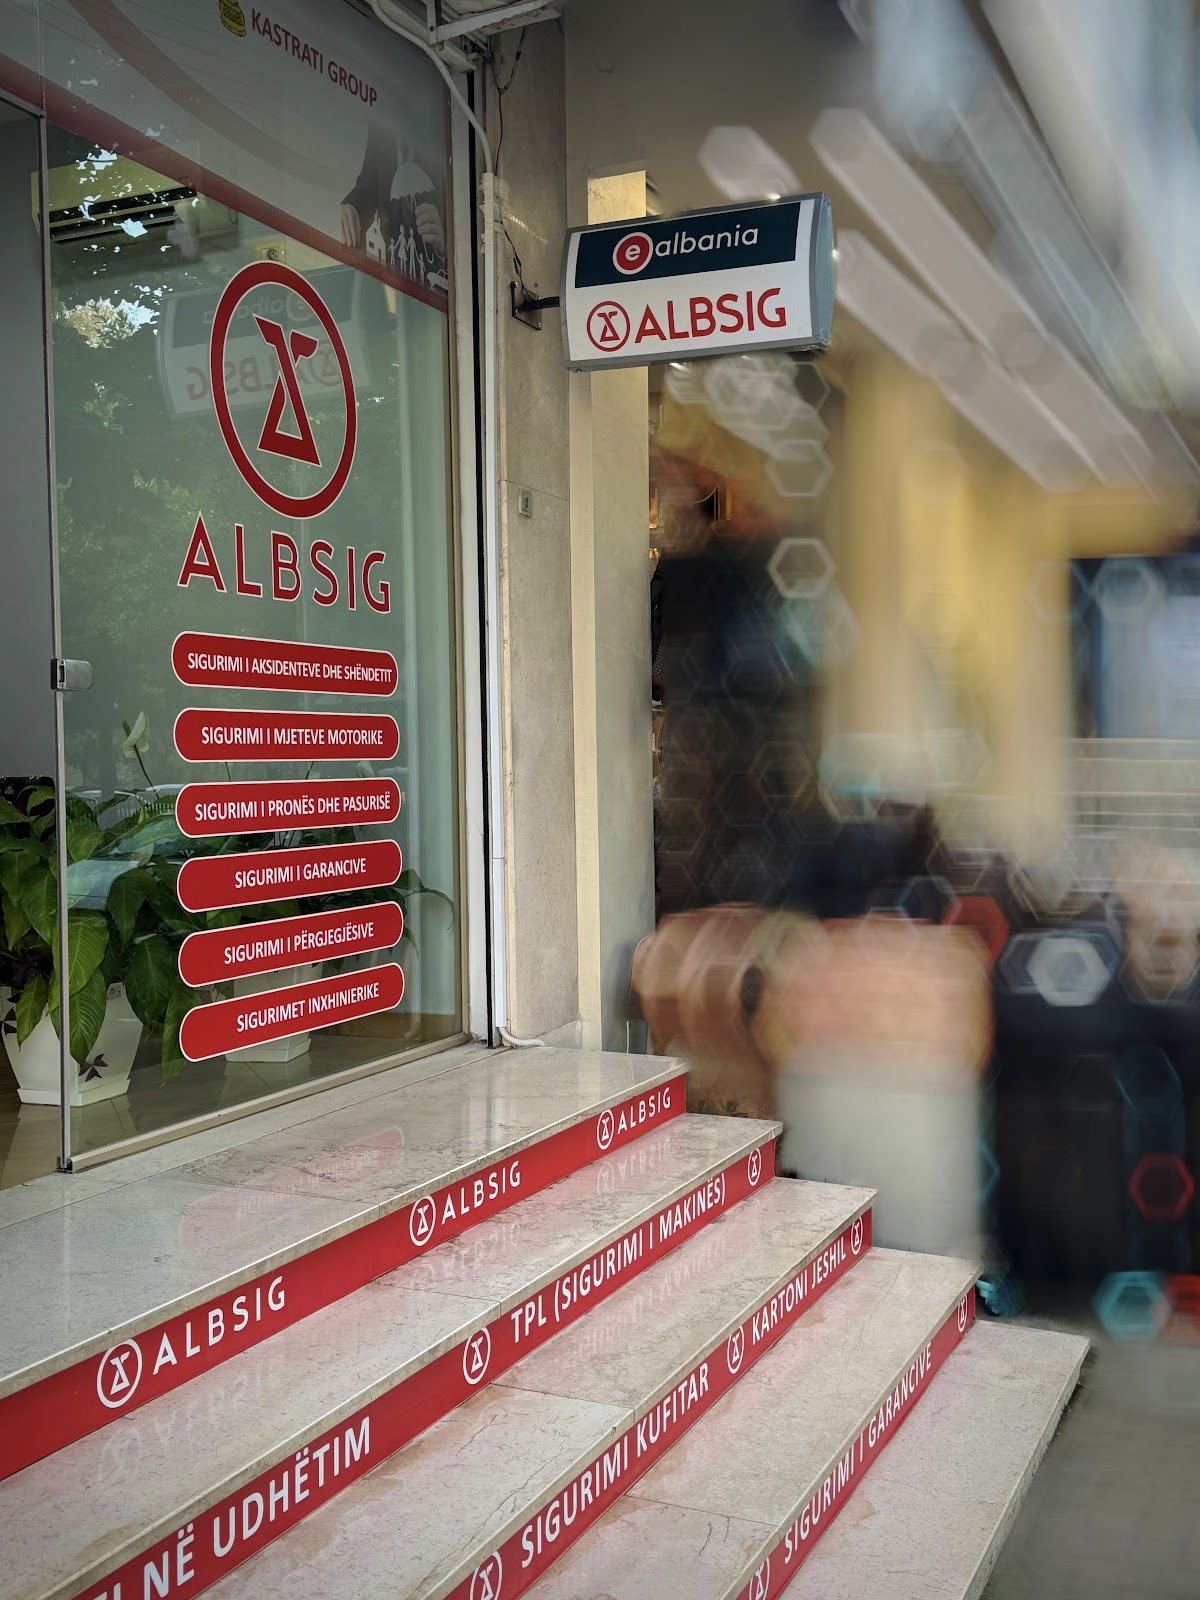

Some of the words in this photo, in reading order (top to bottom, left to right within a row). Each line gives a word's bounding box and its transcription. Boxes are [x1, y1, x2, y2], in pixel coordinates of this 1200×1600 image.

[251, 8, 323, 74] KASTRATI
[328, 60, 377, 107] GROUP
[624, 243, 641, 260] e
[655, 224, 759, 258] albania
[634, 287, 787, 344] ALBSIG
[177, 510, 391, 615] ALBSIG
[187, 653, 243, 673] SIGURIMI
[245, 657, 250, 673] I
[251, 658, 321, 678] AKSIDENTEVE
[323, 664, 342, 680] DHE
[344, 663, 392, 683] SHËNDETIT
[201, 726, 263, 745] SIGURIMI
[266, 728, 271, 745] I
[274, 728, 325, 745] MJETEVE
[327, 729, 383, 745] MOTORIKE
[195, 802, 258, 821] SIGURIMI
[261, 801, 265, 818] I
[268, 795, 315, 817] PRONËS
[317, 799, 340, 814] DHE
[343, 791, 391, 812] PASURISË
[235, 866, 294, 889] SIGURIMI
[296, 865, 301, 881] I
[303, 857, 366, 880] GARANCIVE
[224, 938, 284, 965] SIGURIMI
[287, 937, 291, 953] I
[294, 921, 374, 951] PËRGJEGJËSIVE
[236, 1000, 305, 1033] SIGURIMET
[308, 982, 380, 1014] INXHINIERIKE
[617, 1087, 671, 1135] ALBSIG
[441, 1160, 521, 1225] ALBSIG
[511, 1295, 547, 1343] TPL
[554, 1228, 643, 1322] (SIGURIMI
[649, 1222, 653, 1250] I
[659, 1172, 726, 1243] MAKINËS)
[752, 1269, 808, 1346] KARTONI
[811, 1236, 847, 1290] JESHIL
[152, 1276, 285, 1376] ALBSIG
[521, 1435, 628, 1569] SIGURIMI
[636, 1362, 709, 1458] KUFITAR
[784, 1444, 854, 1564] SIGURIMI
[859, 1431, 864, 1463] I
[868, 1342, 932, 1448] GARANCIVE
[143, 1522, 195, 1600] NË
[213, 1416, 370, 1558] UDHËTIM
